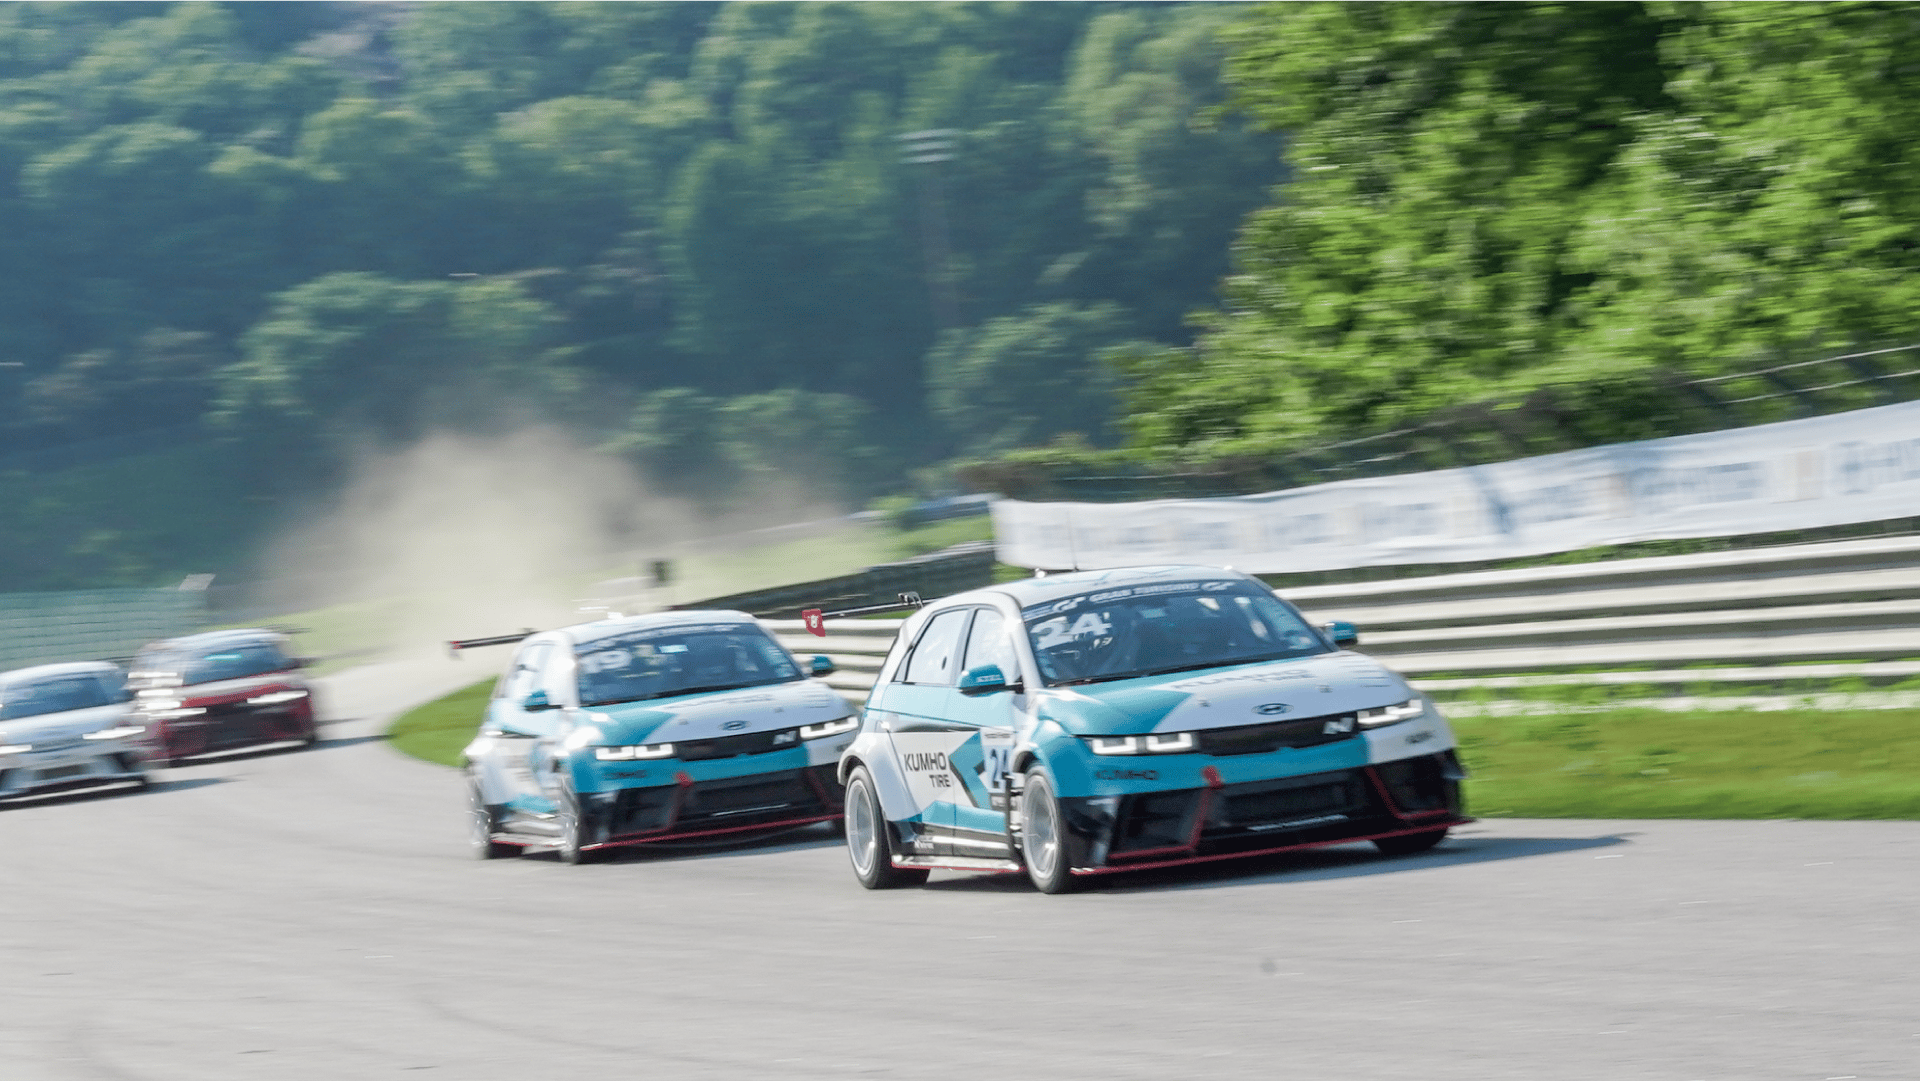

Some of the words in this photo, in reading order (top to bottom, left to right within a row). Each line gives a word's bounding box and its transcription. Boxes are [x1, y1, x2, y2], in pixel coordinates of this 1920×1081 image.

[1030, 613, 1113, 650] 24
[903, 752, 947, 771] KUMHO
[929, 774, 951, 788] TIRE
